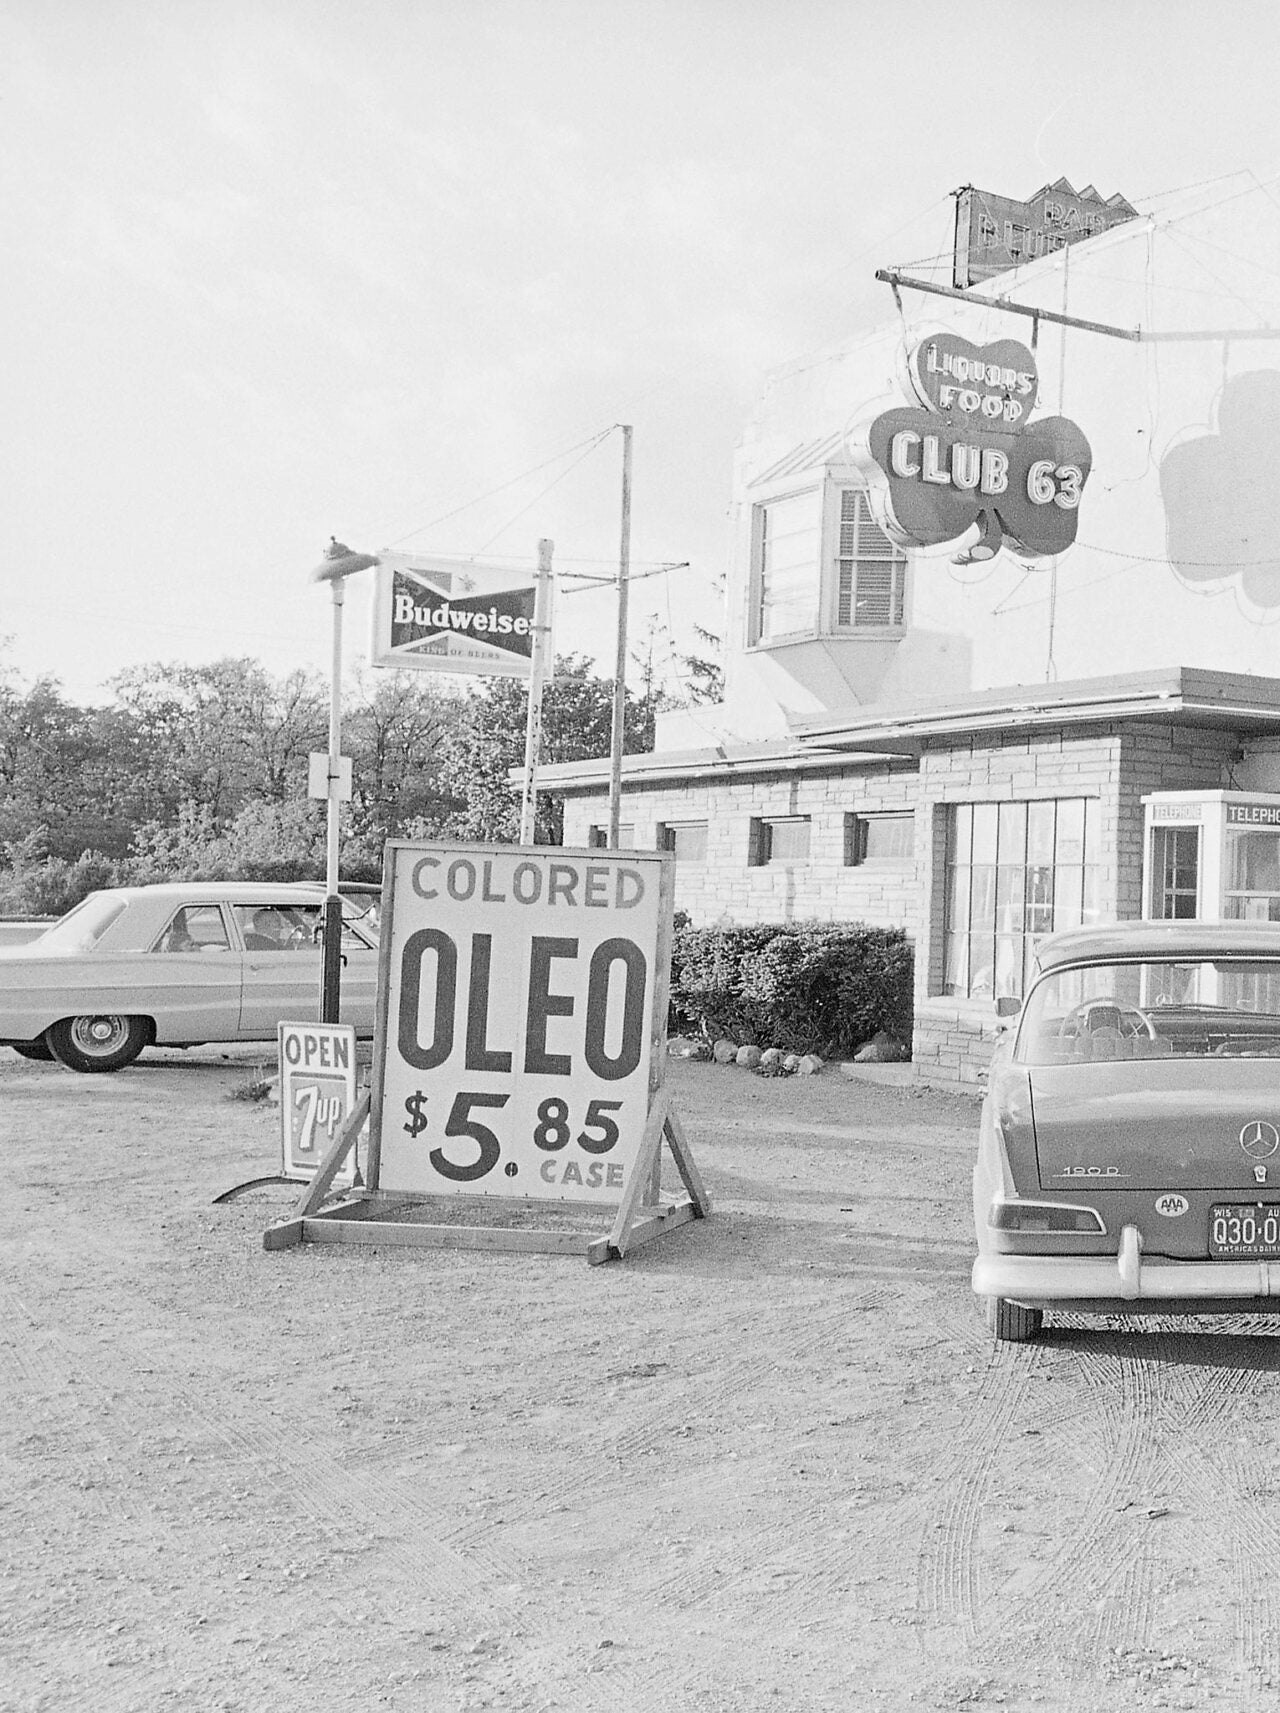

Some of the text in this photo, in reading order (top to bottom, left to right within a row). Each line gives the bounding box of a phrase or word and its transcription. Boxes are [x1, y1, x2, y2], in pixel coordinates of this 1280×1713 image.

[926, 343, 1035, 395] LIQUORS
[940, 384, 1023, 422] FOOD
[891, 429, 1083, 510] CLUB 63
[411, 857, 645, 909] COLORED
[398, 928, 647, 1081] OLEO
[285, 1033, 349, 1069] OPEN
[539, 1159, 625, 1188] CASE
